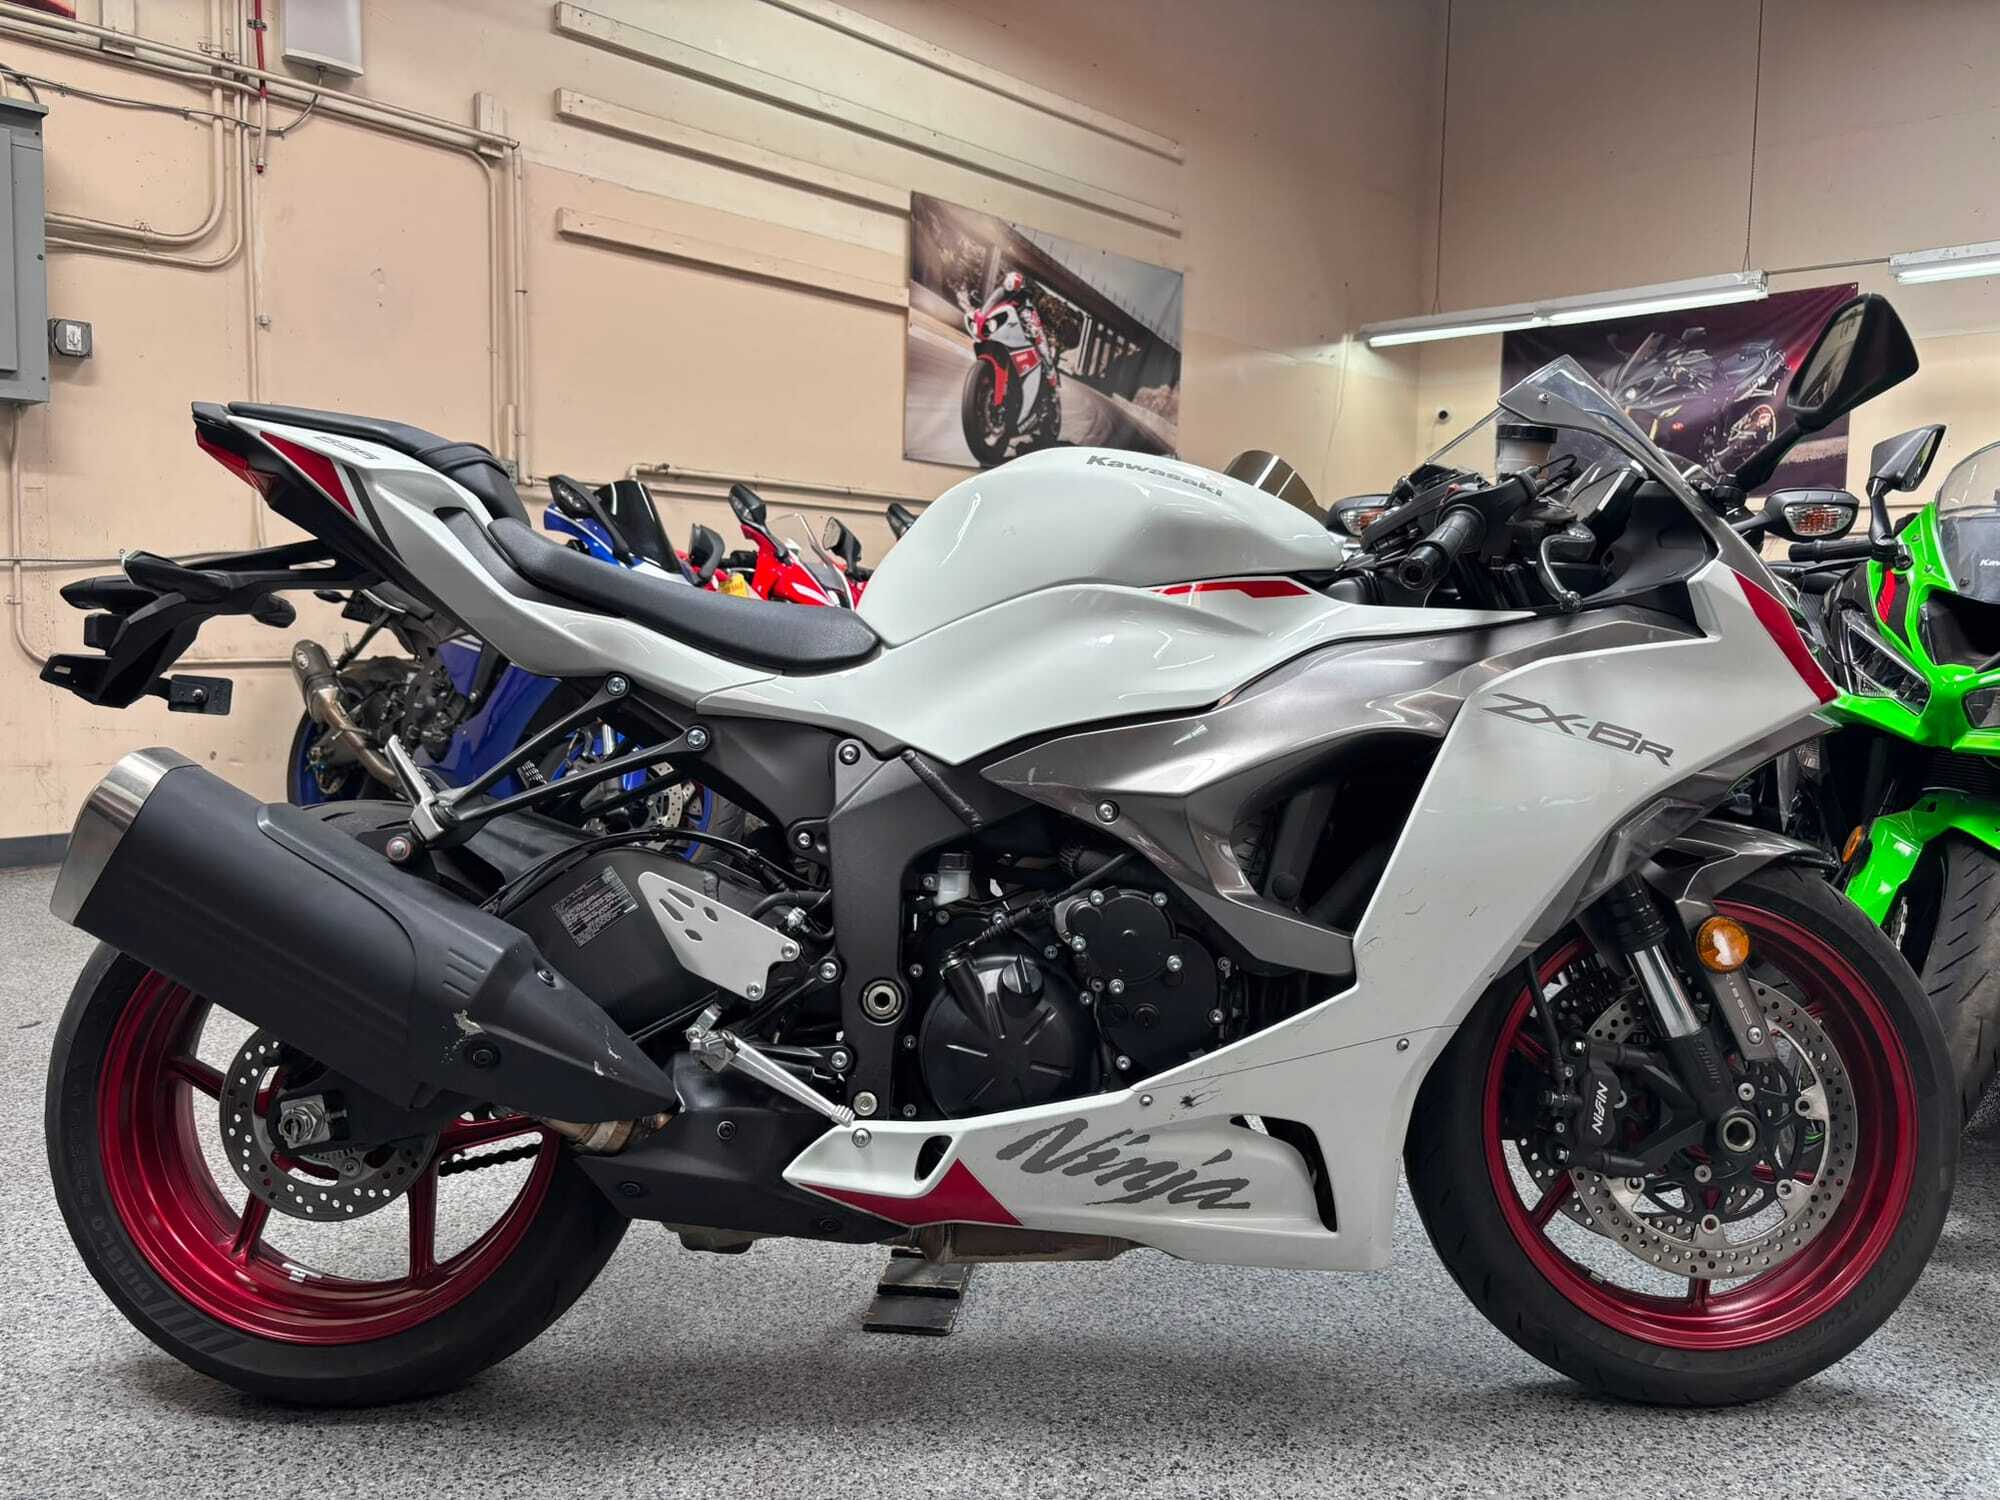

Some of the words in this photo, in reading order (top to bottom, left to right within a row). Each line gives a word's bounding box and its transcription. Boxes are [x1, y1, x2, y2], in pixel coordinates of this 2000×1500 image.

[1086, 455, 1223, 497] Kawasaki
[1480, 692, 1674, 767] ZX-6R
[1591, 1080, 1609, 1135] NISSIN
[996, 1118, 1251, 1210] Ninja
